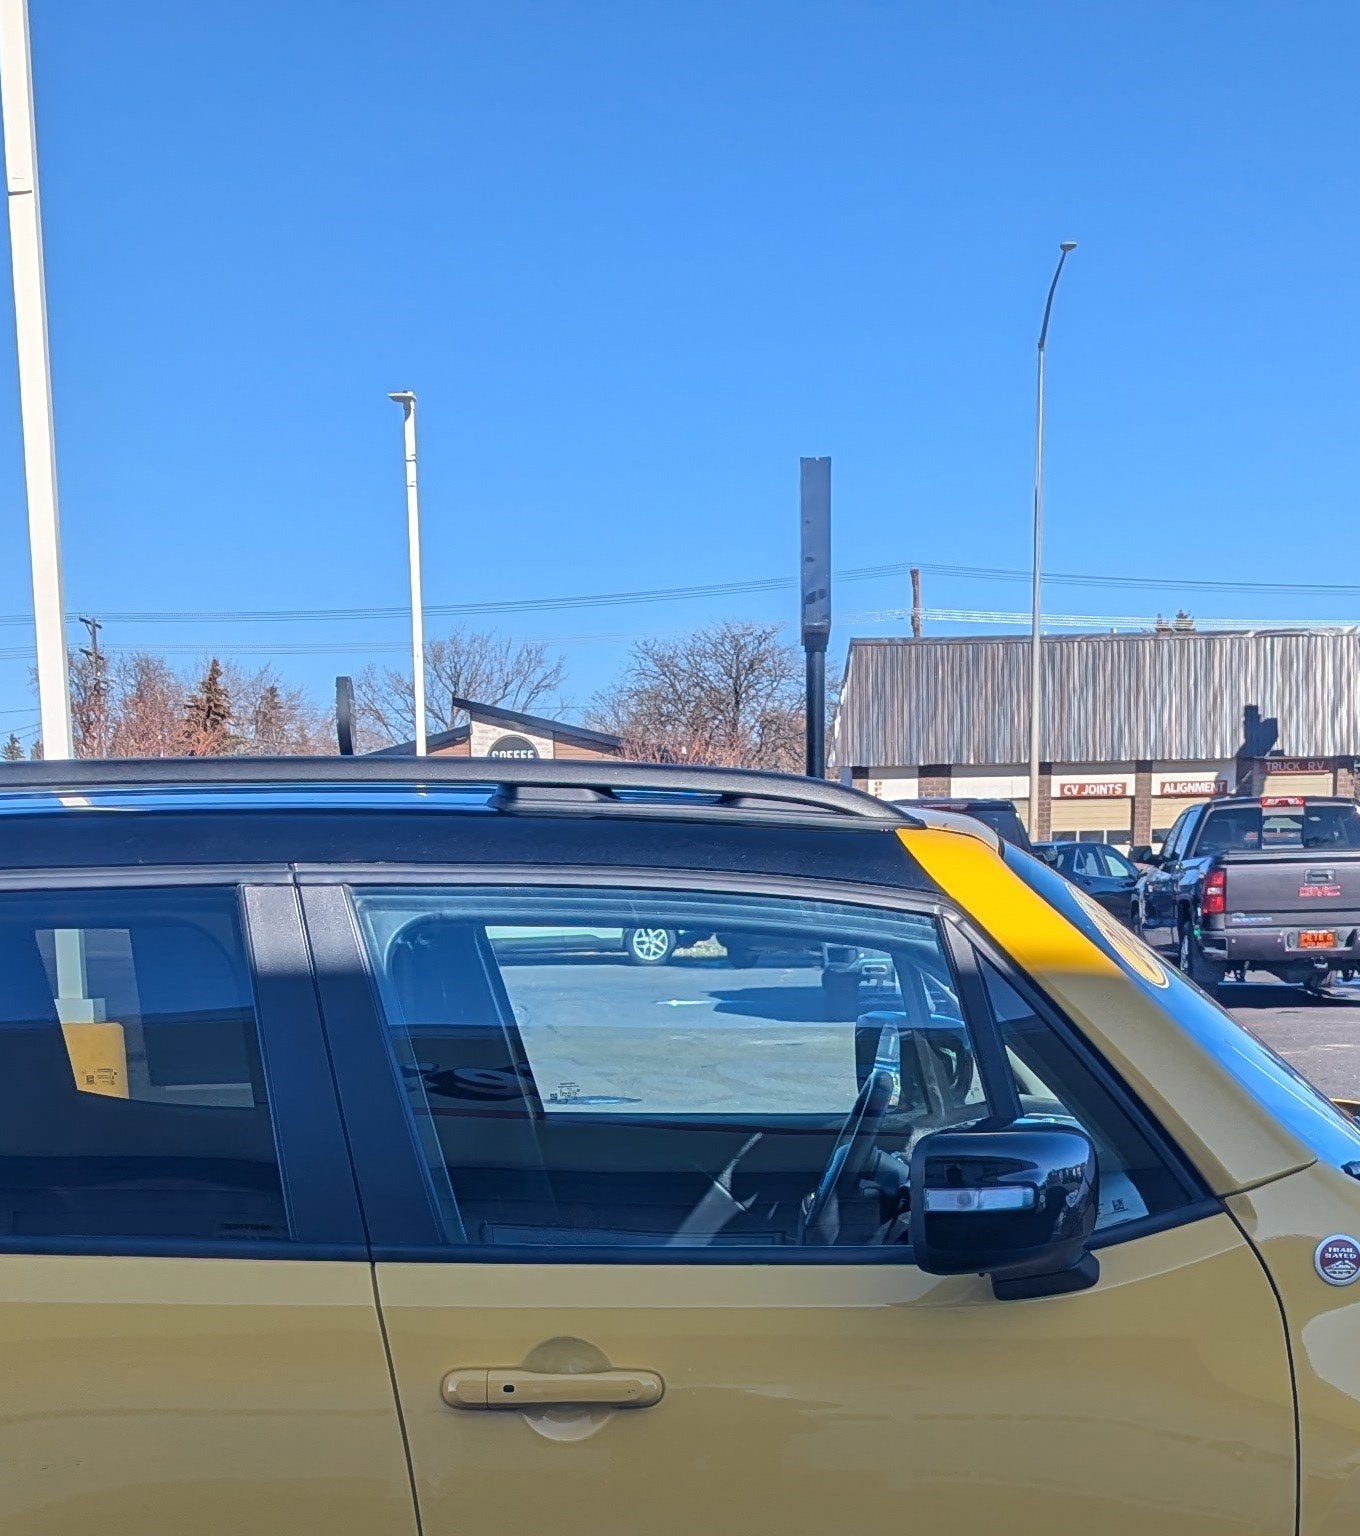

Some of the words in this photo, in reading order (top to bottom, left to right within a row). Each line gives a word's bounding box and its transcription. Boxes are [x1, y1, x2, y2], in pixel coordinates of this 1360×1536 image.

[1265, 761, 1301, 772] TRUCK
[1307, 760, 1326, 771] RV
[1063, 783, 1080, 796] CV
[1080, 783, 1123, 796] JOINTS
[1163, 780, 1225, 794] ALIGNMENT
